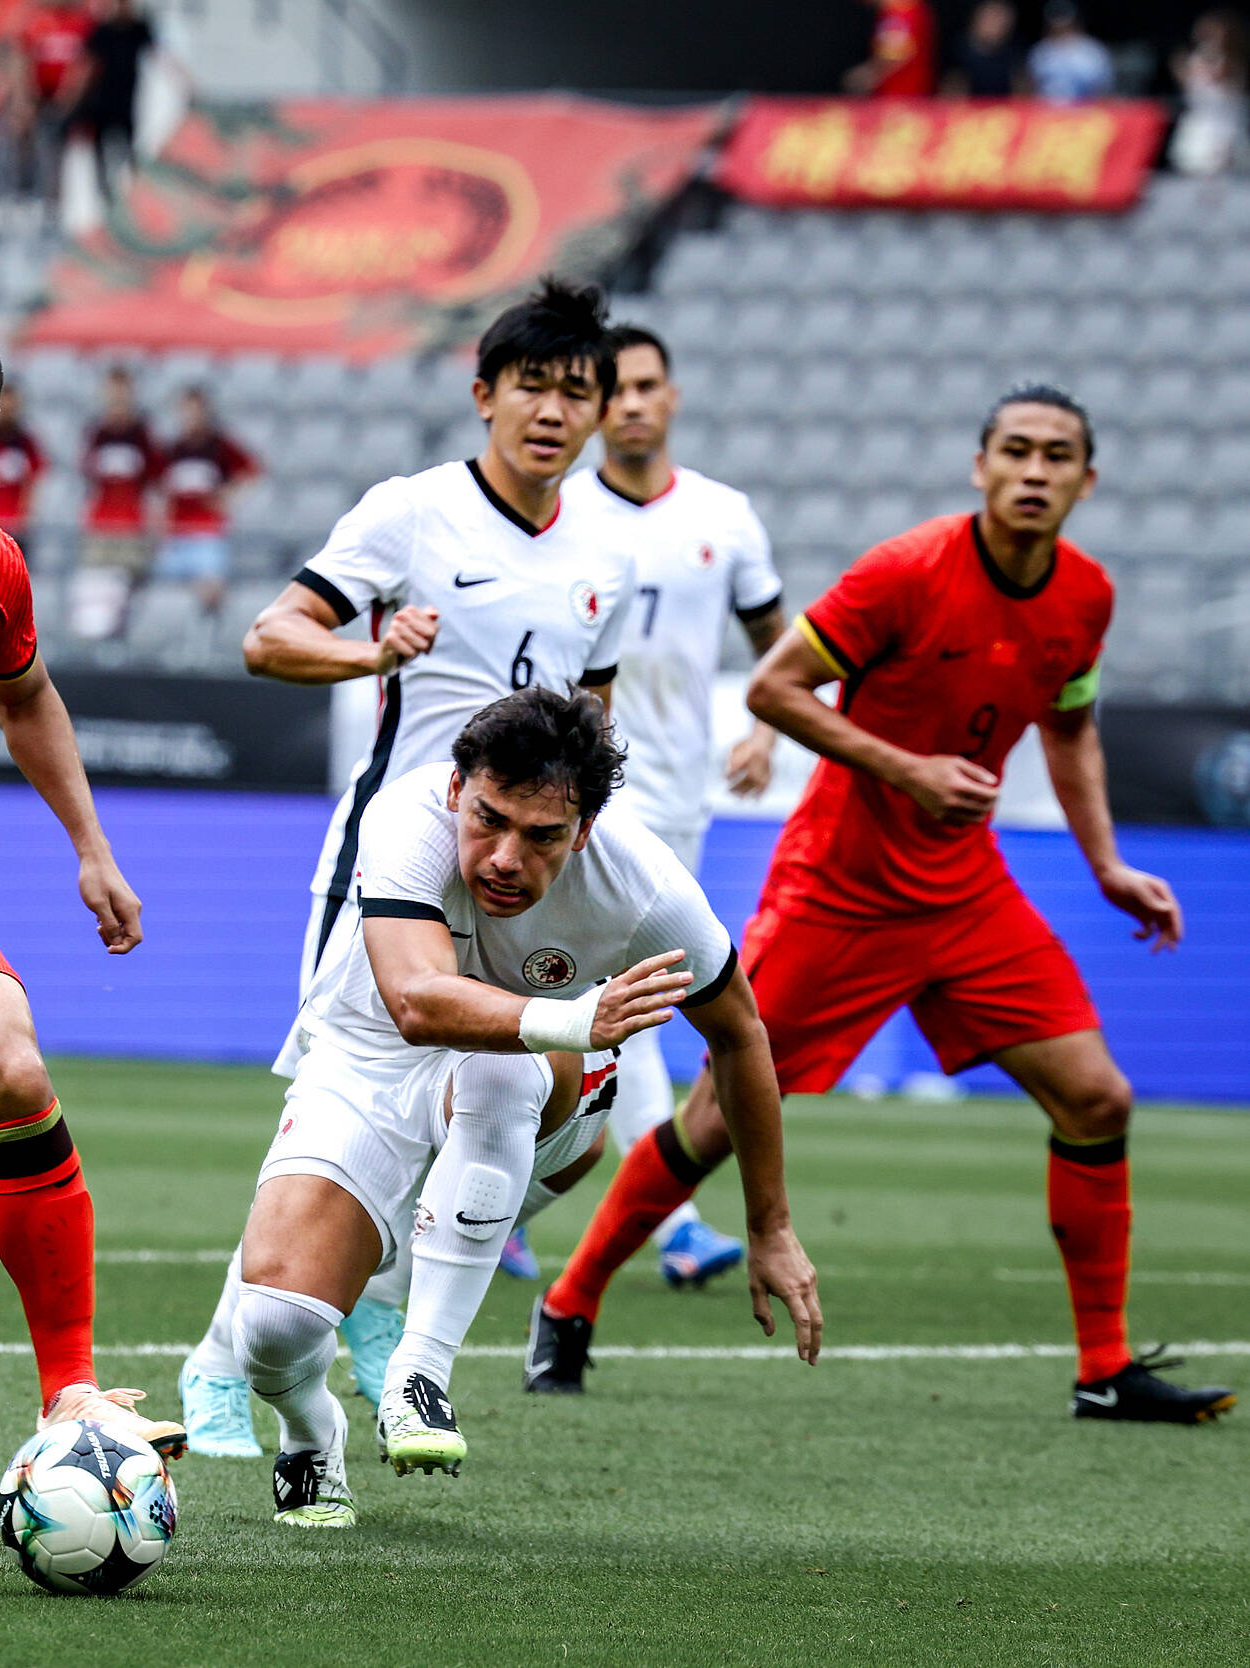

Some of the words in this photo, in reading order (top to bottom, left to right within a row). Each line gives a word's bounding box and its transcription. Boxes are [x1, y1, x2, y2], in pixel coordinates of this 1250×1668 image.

[640, 585, 659, 638] 7
[511, 630, 534, 690] 6
[960, 703, 999, 759] 9
